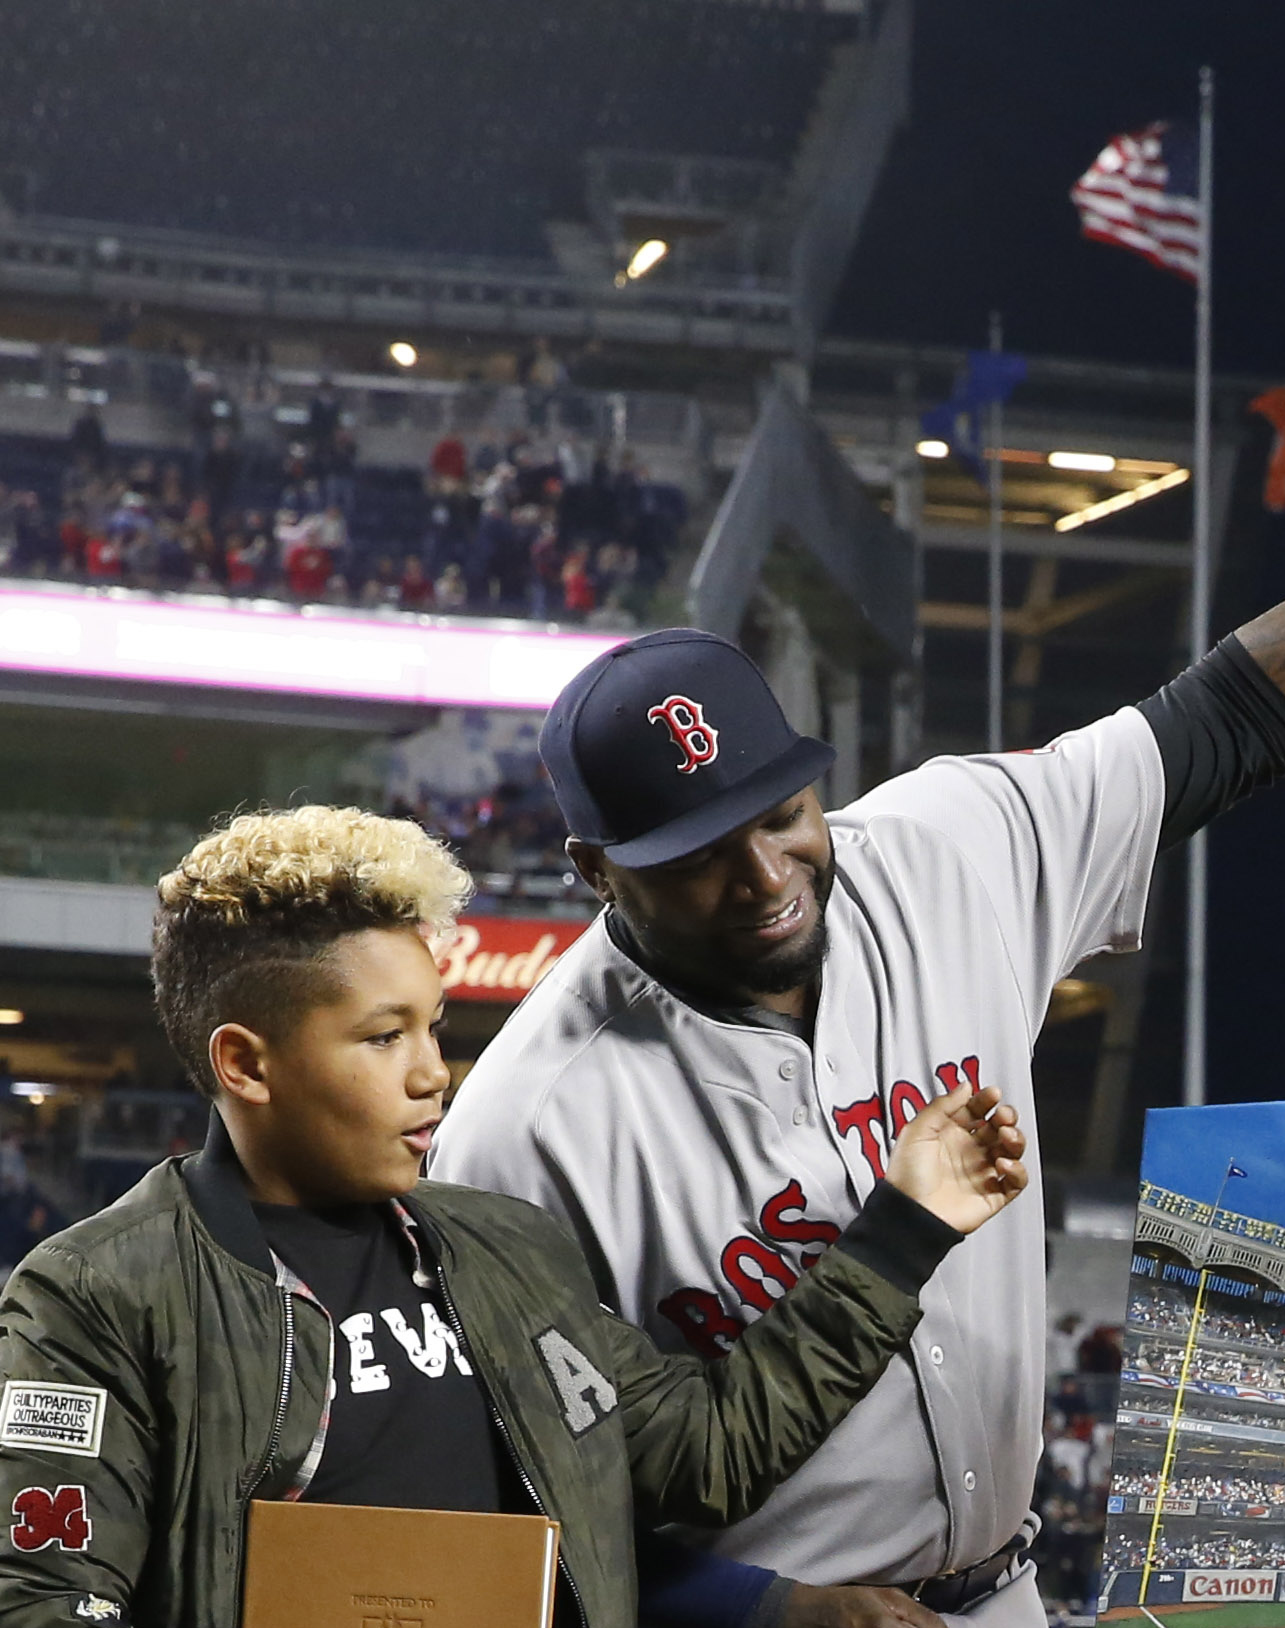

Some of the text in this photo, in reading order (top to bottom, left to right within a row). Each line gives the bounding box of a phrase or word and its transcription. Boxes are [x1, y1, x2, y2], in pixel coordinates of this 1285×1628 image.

[647, 693, 719, 775] B
[428, 923, 558, 990] Bud
[537, 1326, 619, 1434] A
[14, 1409, 85, 1428] OUTRAGEOUS
[10, 1484, 93, 1553] 34
[1189, 1575, 1274, 1597] Canon
